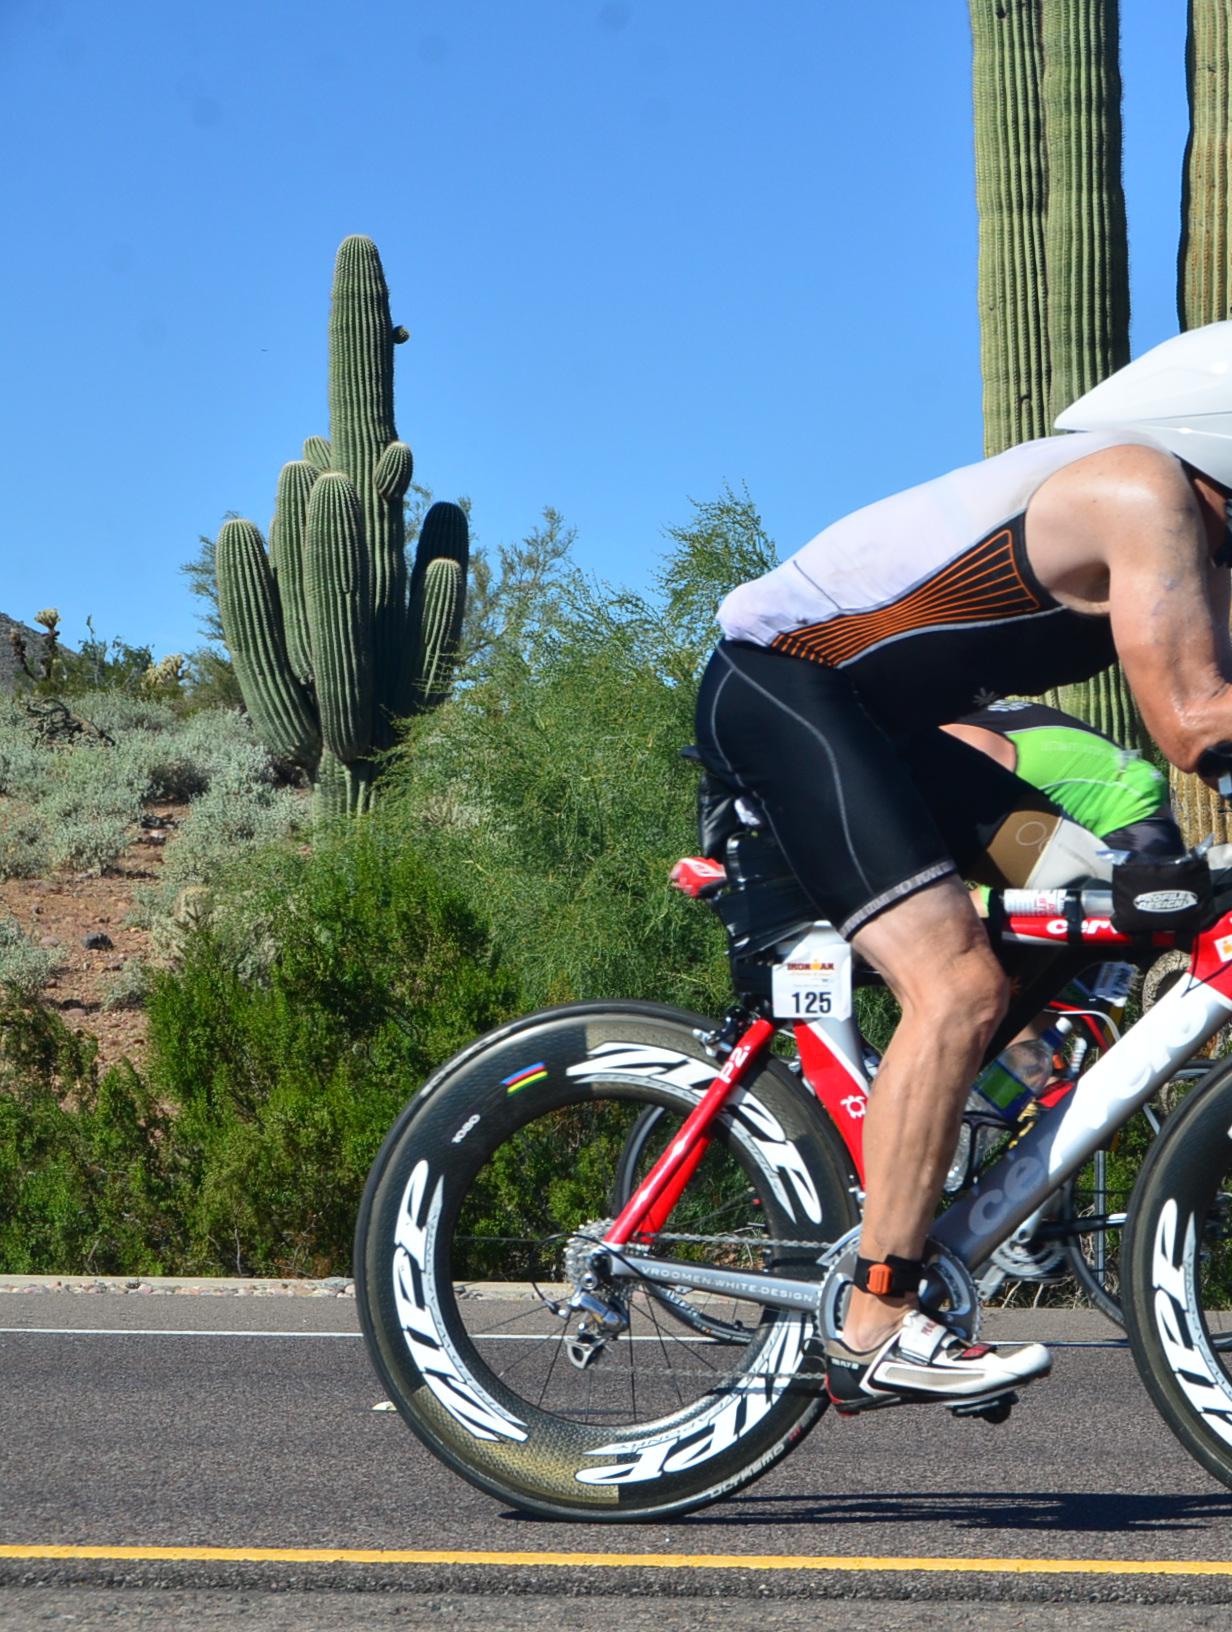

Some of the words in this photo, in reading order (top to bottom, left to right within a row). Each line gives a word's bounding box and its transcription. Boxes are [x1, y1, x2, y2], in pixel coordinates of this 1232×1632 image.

[791, 991, 832, 1014] 125
[451, 1114, 481, 1144] 1080
[392, 1159, 529, 1442] ZIPP
[575, 1310, 813, 1485] ZIPP
